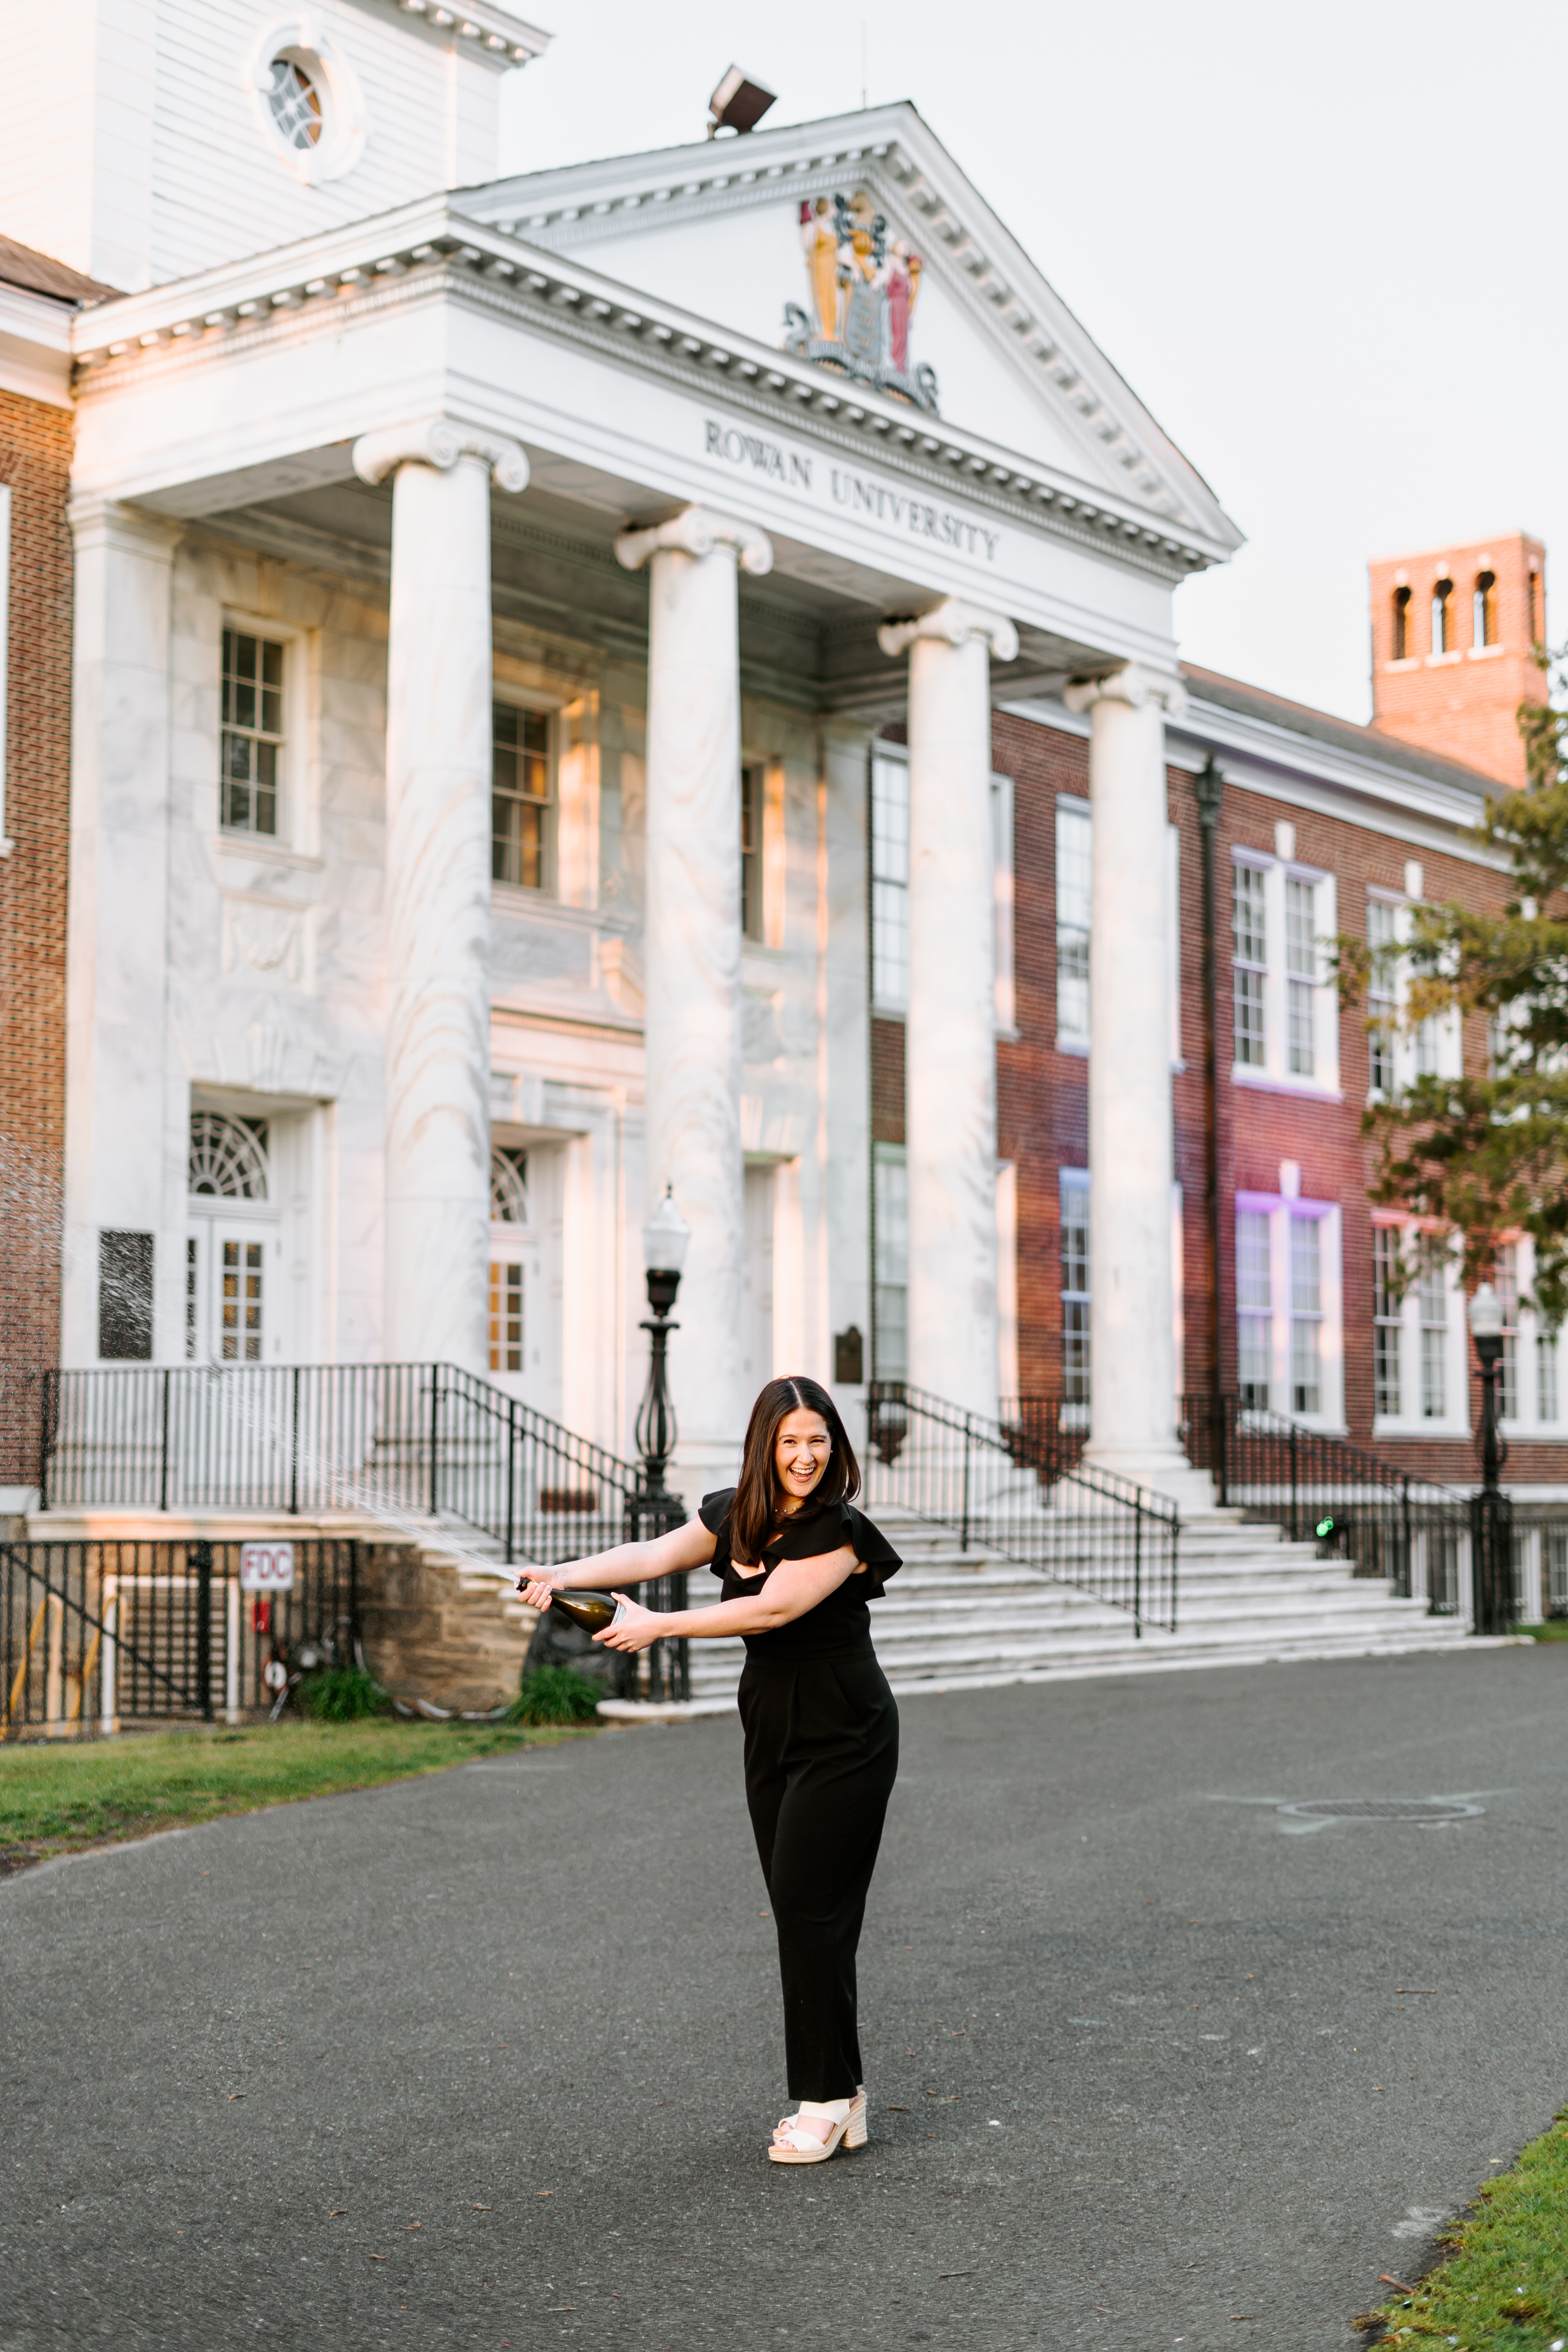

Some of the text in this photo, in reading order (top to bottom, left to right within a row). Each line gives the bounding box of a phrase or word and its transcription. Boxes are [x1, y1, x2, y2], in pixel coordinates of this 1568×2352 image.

[705, 419, 1000, 561] ROWAN UNIVERSITY
[242, 1550, 291, 1579] FDC
